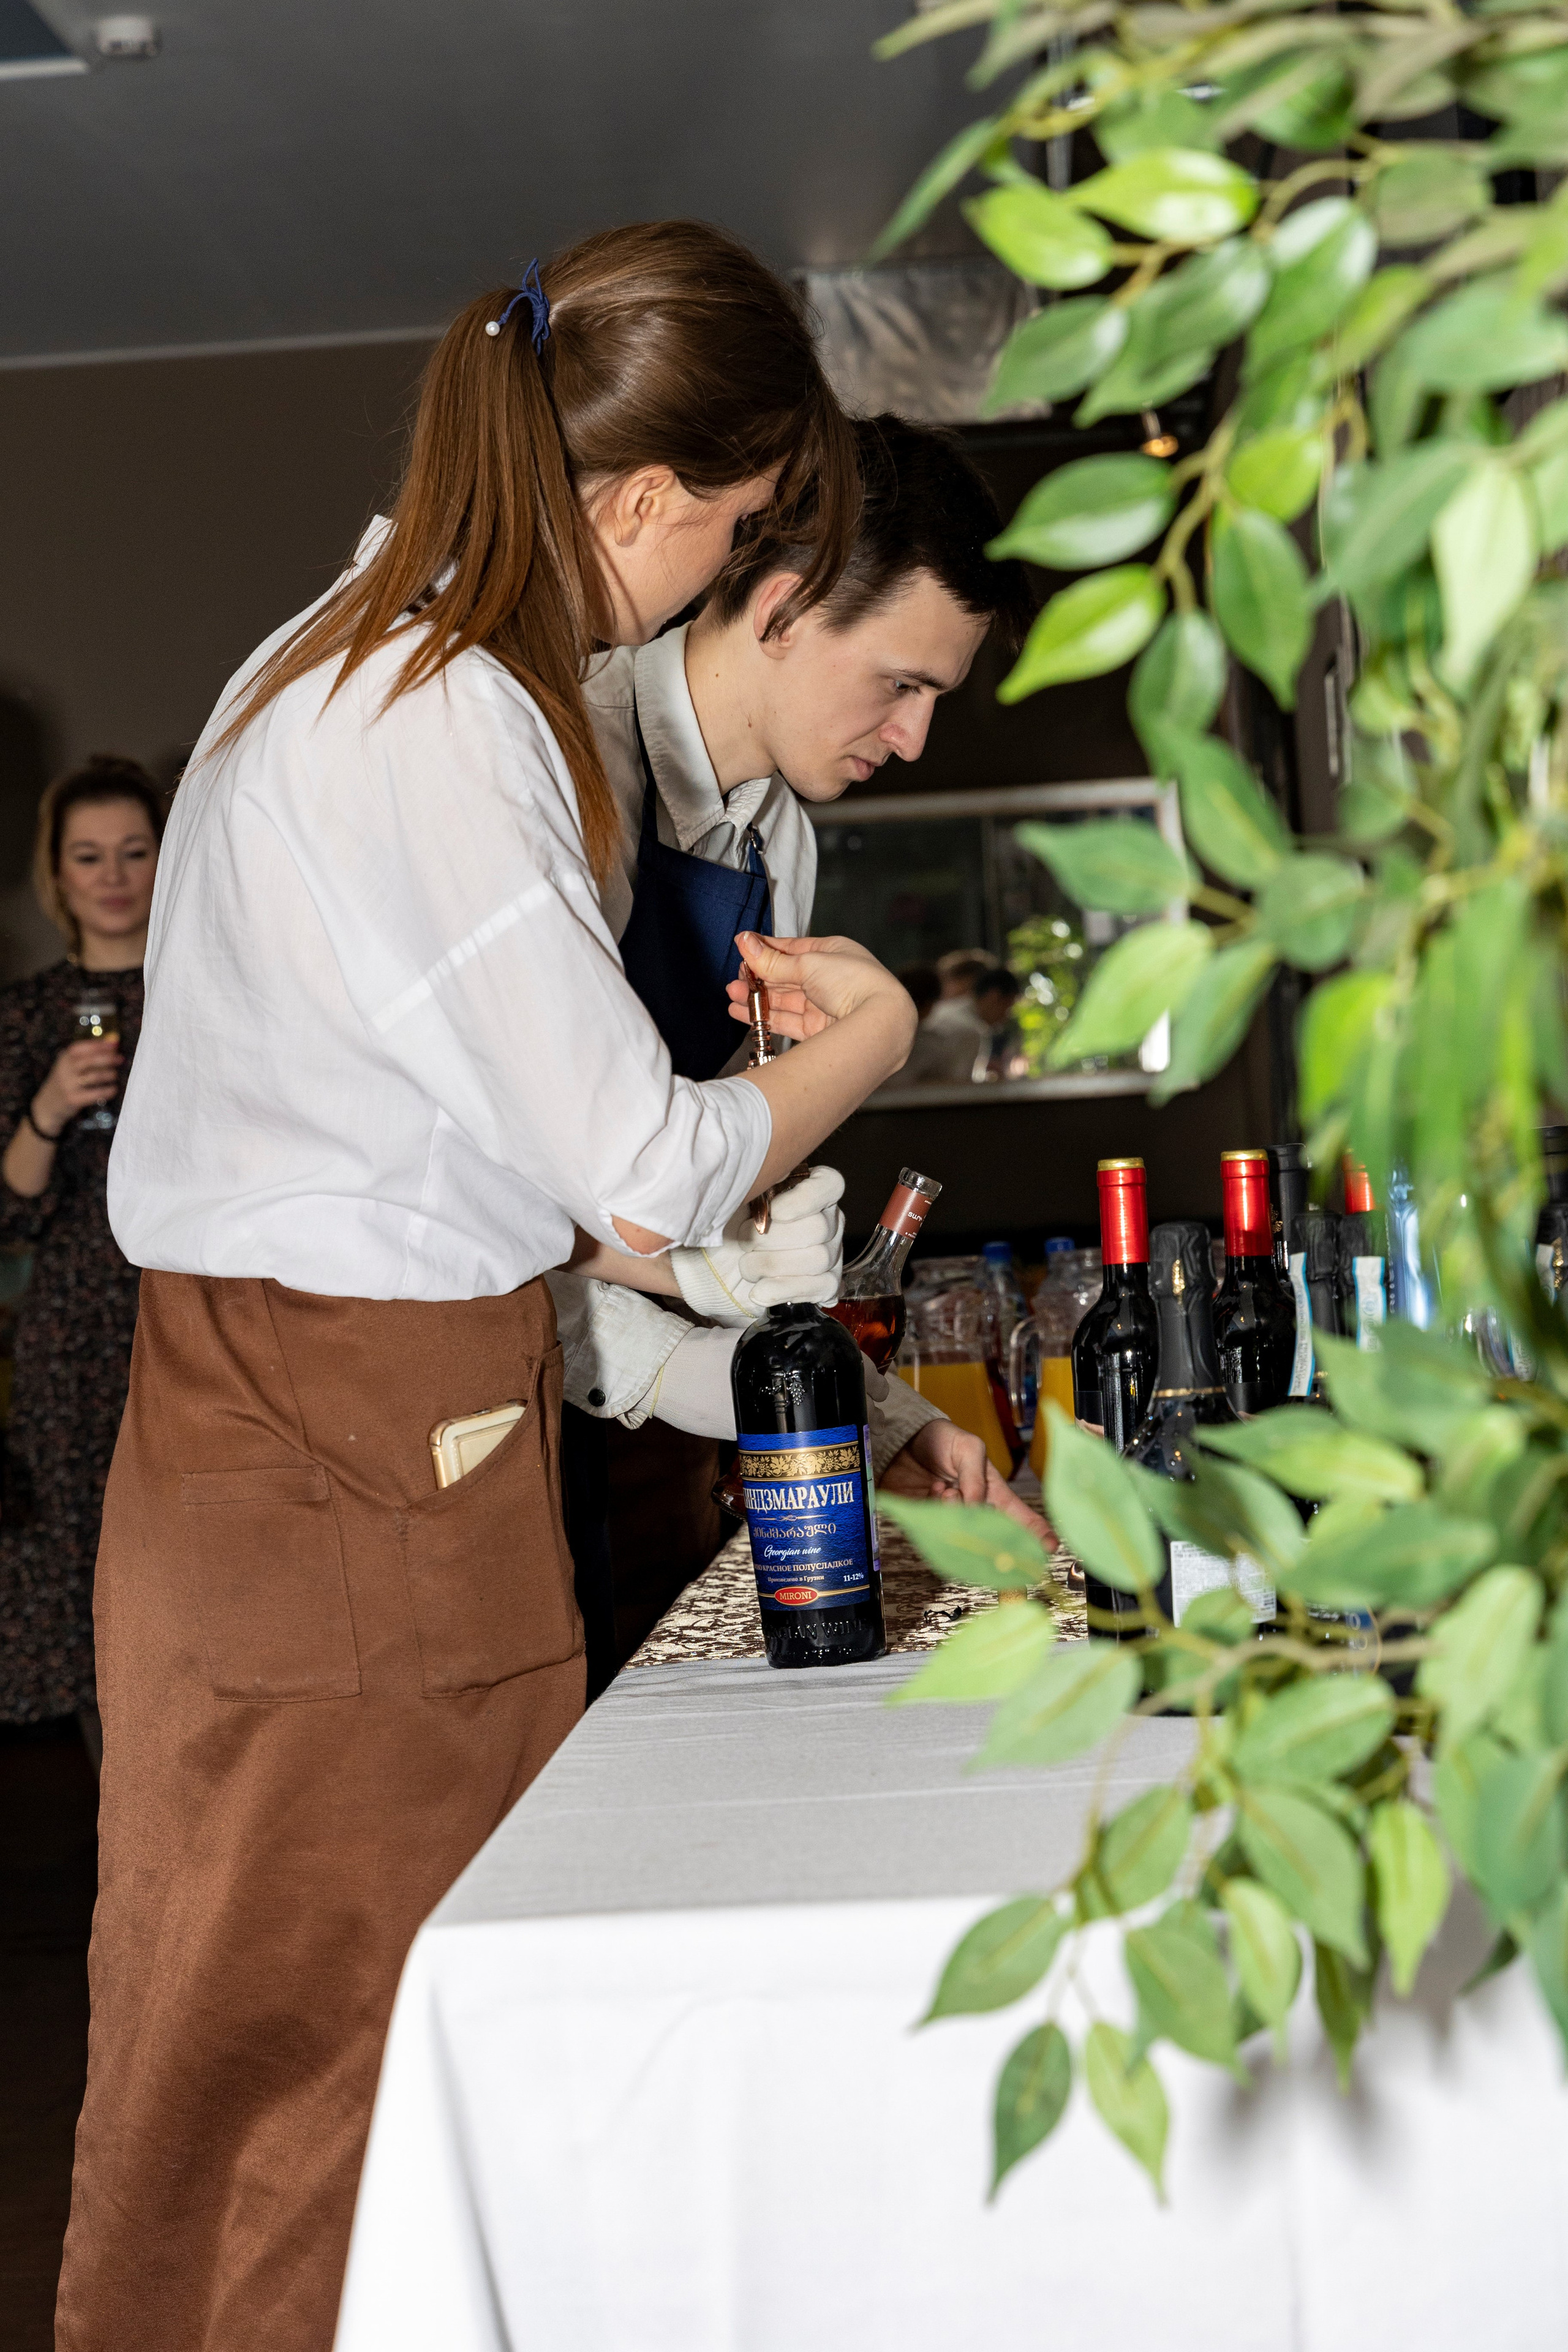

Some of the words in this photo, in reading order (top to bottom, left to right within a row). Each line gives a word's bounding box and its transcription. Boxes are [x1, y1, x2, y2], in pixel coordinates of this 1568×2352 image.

[744, 1482, 854, 1514] ИНДЗМАРАУЛИ
[764, 1544, 802, 1561] Georgian
[802, 1546, 822, 1556] wine
[793, 1558, 854, 1572] ПОЛУСЛАДКОЕ
[804, 1575, 824, 1583] Грузии
[843, 1572, 864, 1582] 11-12%
[779, 1591, 812, 1601] MIRONI
